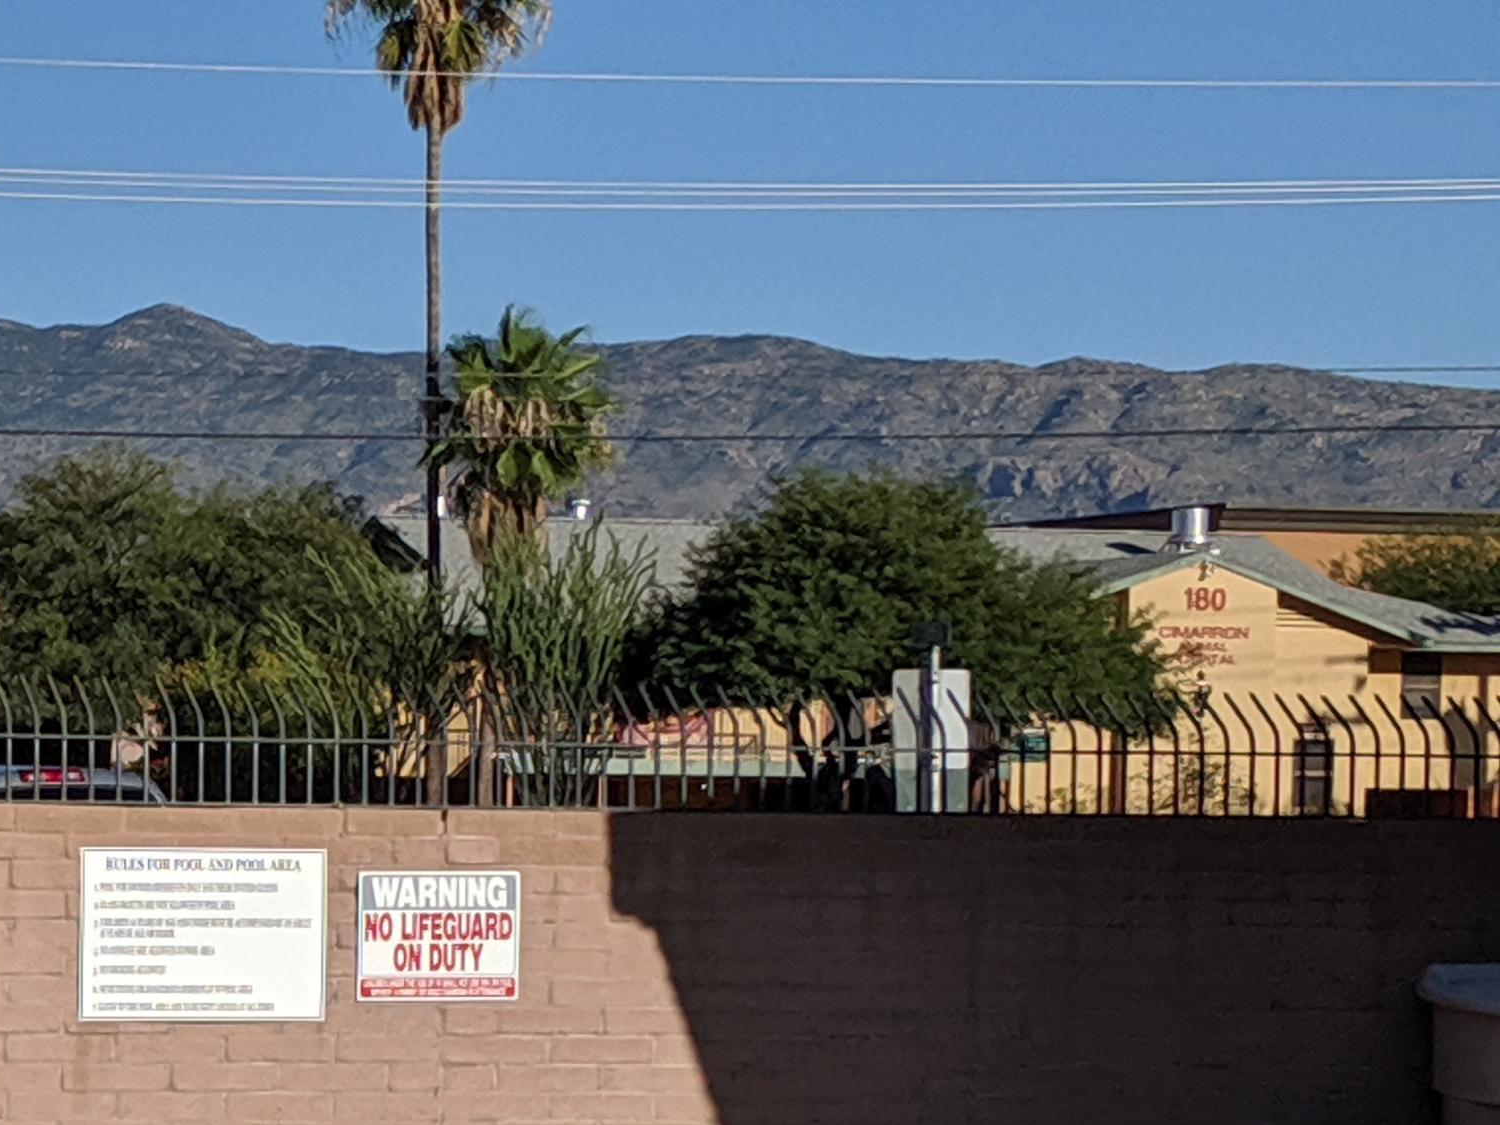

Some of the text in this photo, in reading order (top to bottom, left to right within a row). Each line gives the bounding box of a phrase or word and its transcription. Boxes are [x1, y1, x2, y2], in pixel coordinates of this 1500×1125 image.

[1184, 587, 1226, 611] 180
[1159, 626, 1250, 639] CIMARRON
[106, 857, 302, 873] RULES FOR POOL AND POOL AREA
[372, 876, 508, 909] WARNING
[364, 912, 513, 942] NO LIFEGUARD
[393, 943, 483, 972] ON DUTY
